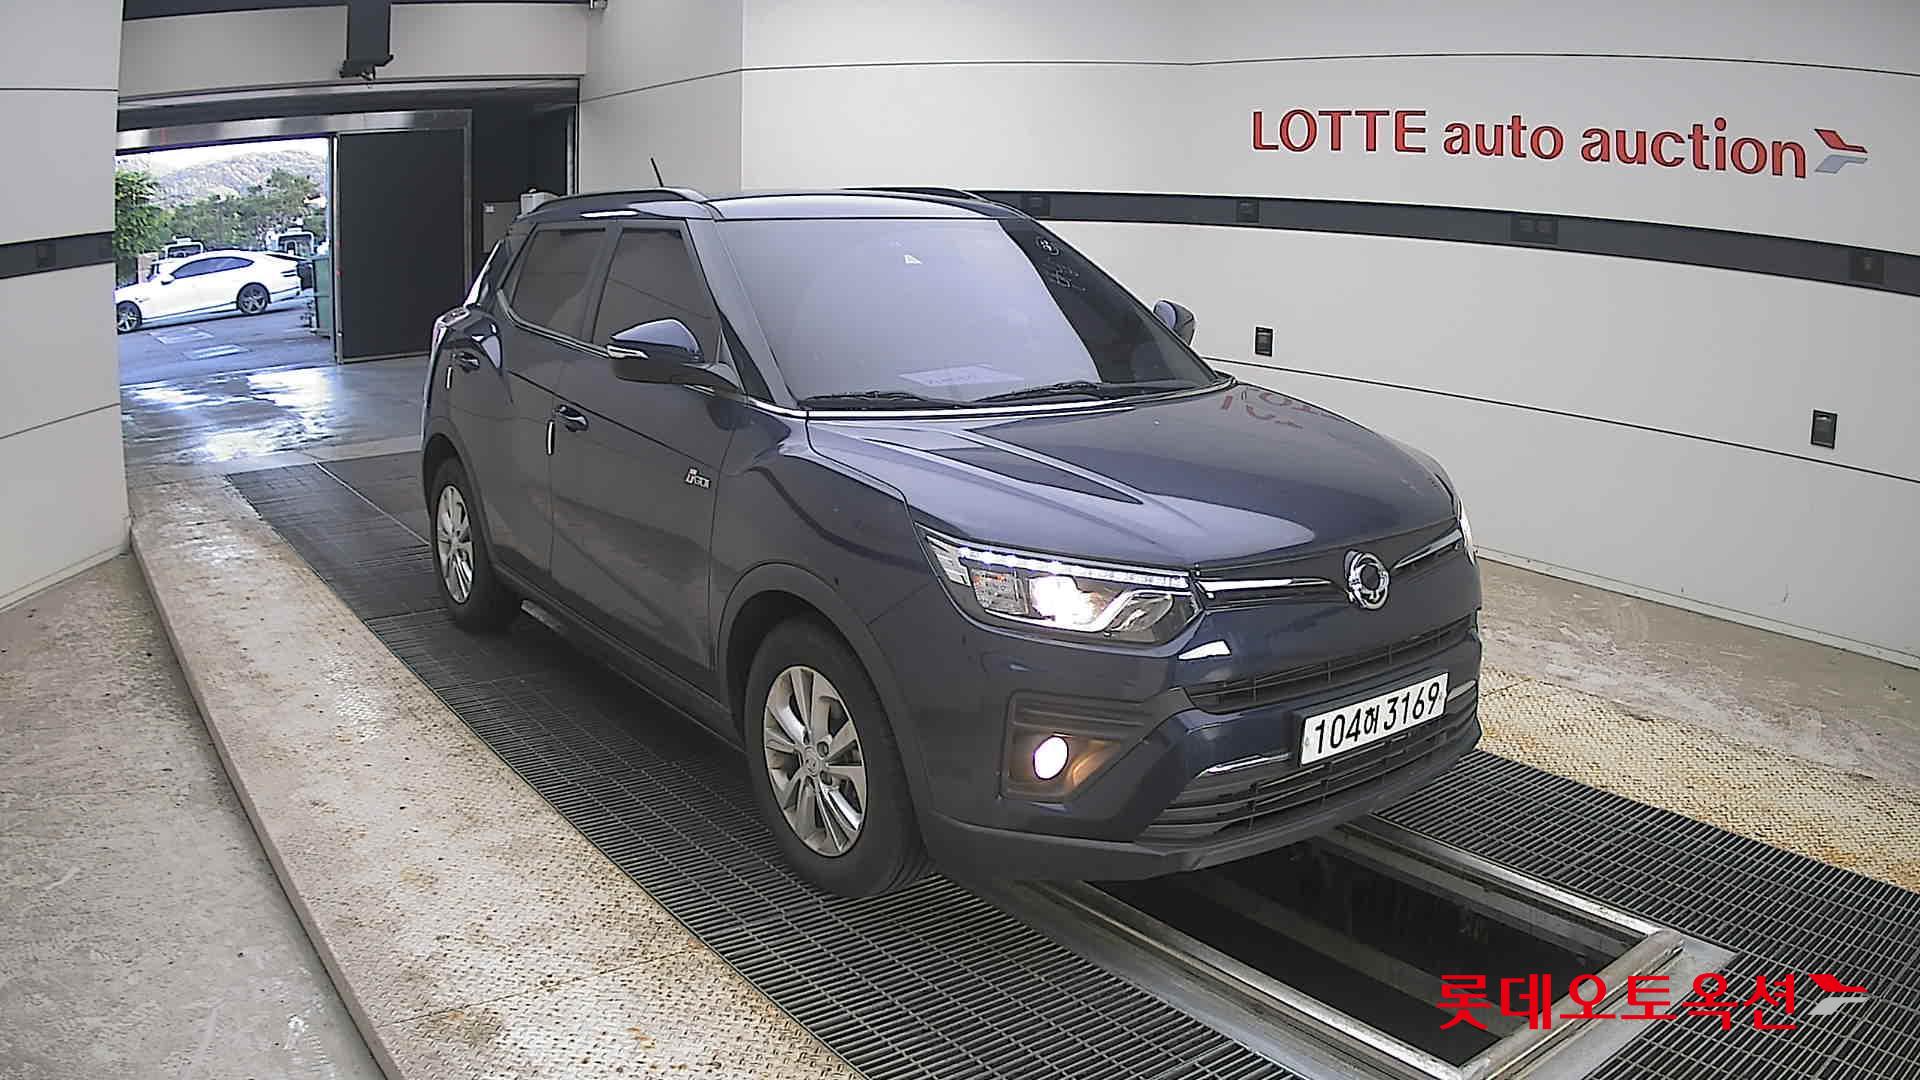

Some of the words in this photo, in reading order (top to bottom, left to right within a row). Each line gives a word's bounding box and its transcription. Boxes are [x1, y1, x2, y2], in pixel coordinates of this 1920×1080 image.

[1253, 109, 1426, 153] LOTTE
[1443, 115, 1565, 159] auto
[1581, 117, 1807, 178] auction
[1383, 682, 1440, 731] 3169
